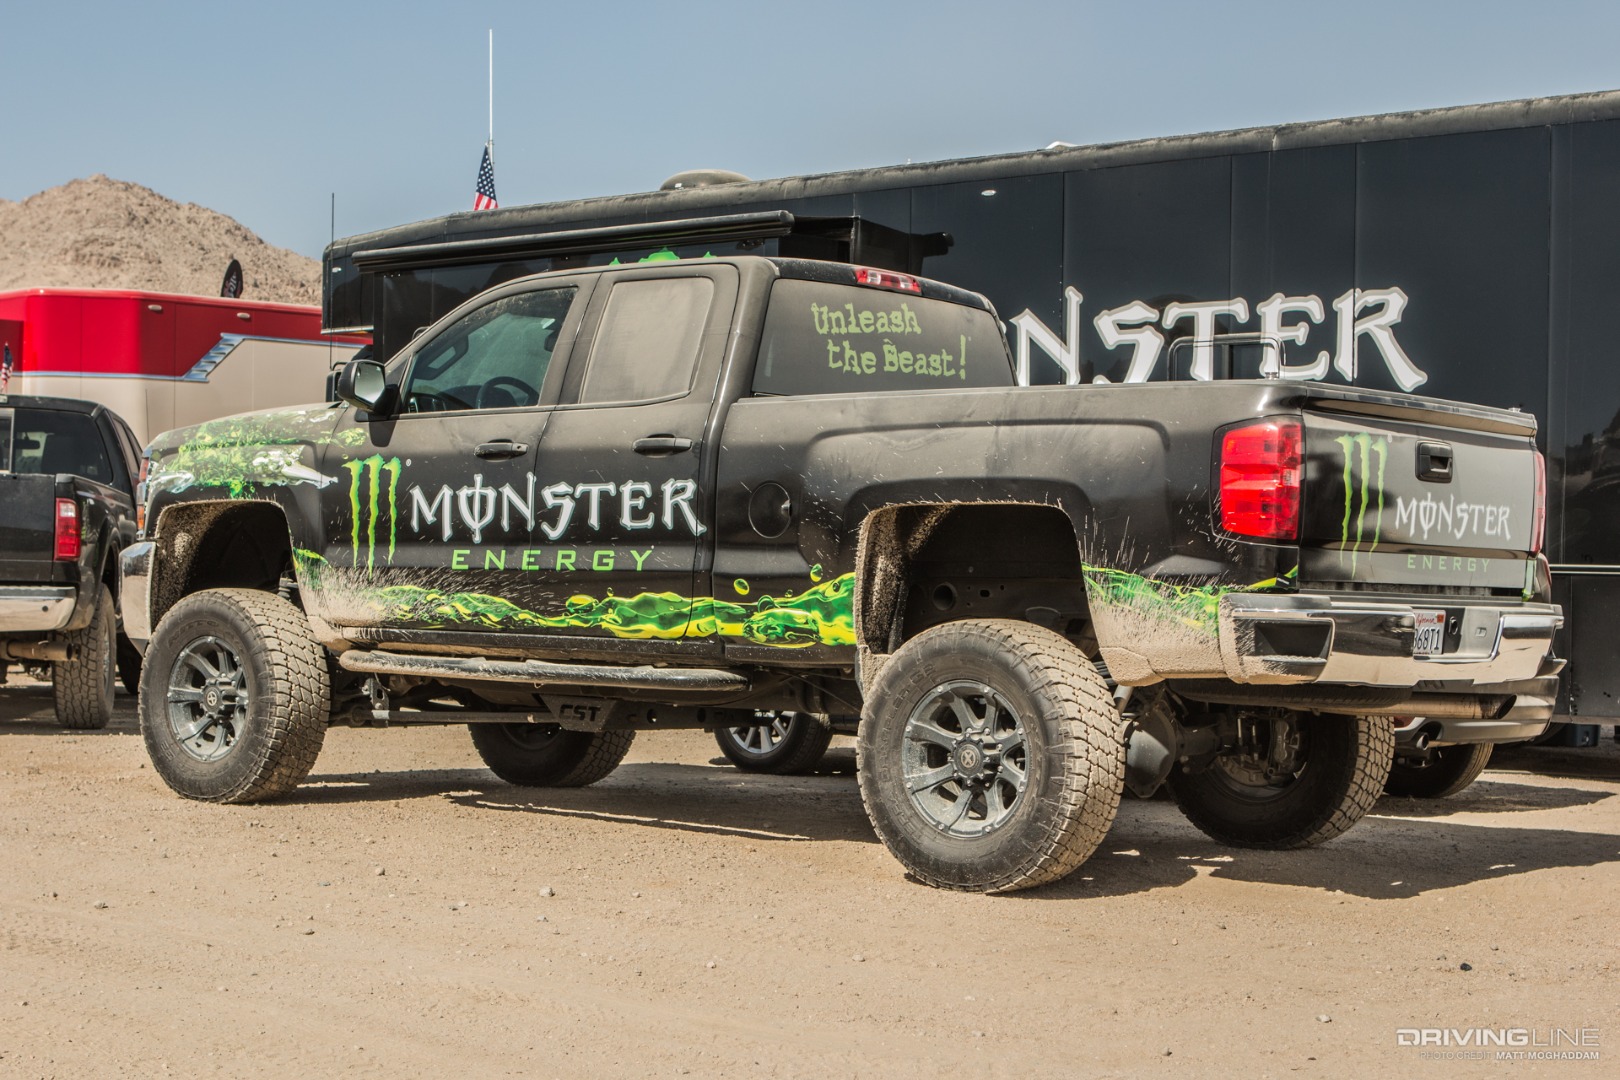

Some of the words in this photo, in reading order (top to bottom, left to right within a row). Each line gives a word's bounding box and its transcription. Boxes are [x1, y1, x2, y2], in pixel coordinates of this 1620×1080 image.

[811, 302, 922, 335] Unleash
[1002, 286, 1428, 392] NSTER
[827, 338, 877, 375] the
[883, 338, 967, 380] Beast!
[410, 472, 707, 543] MONSTER
[1395, 492, 1511, 541] MONSTER
[451, 549, 653, 571] ENERGY
[1407, 554, 1491, 573] ENERGY
[559, 703, 601, 722] CST
